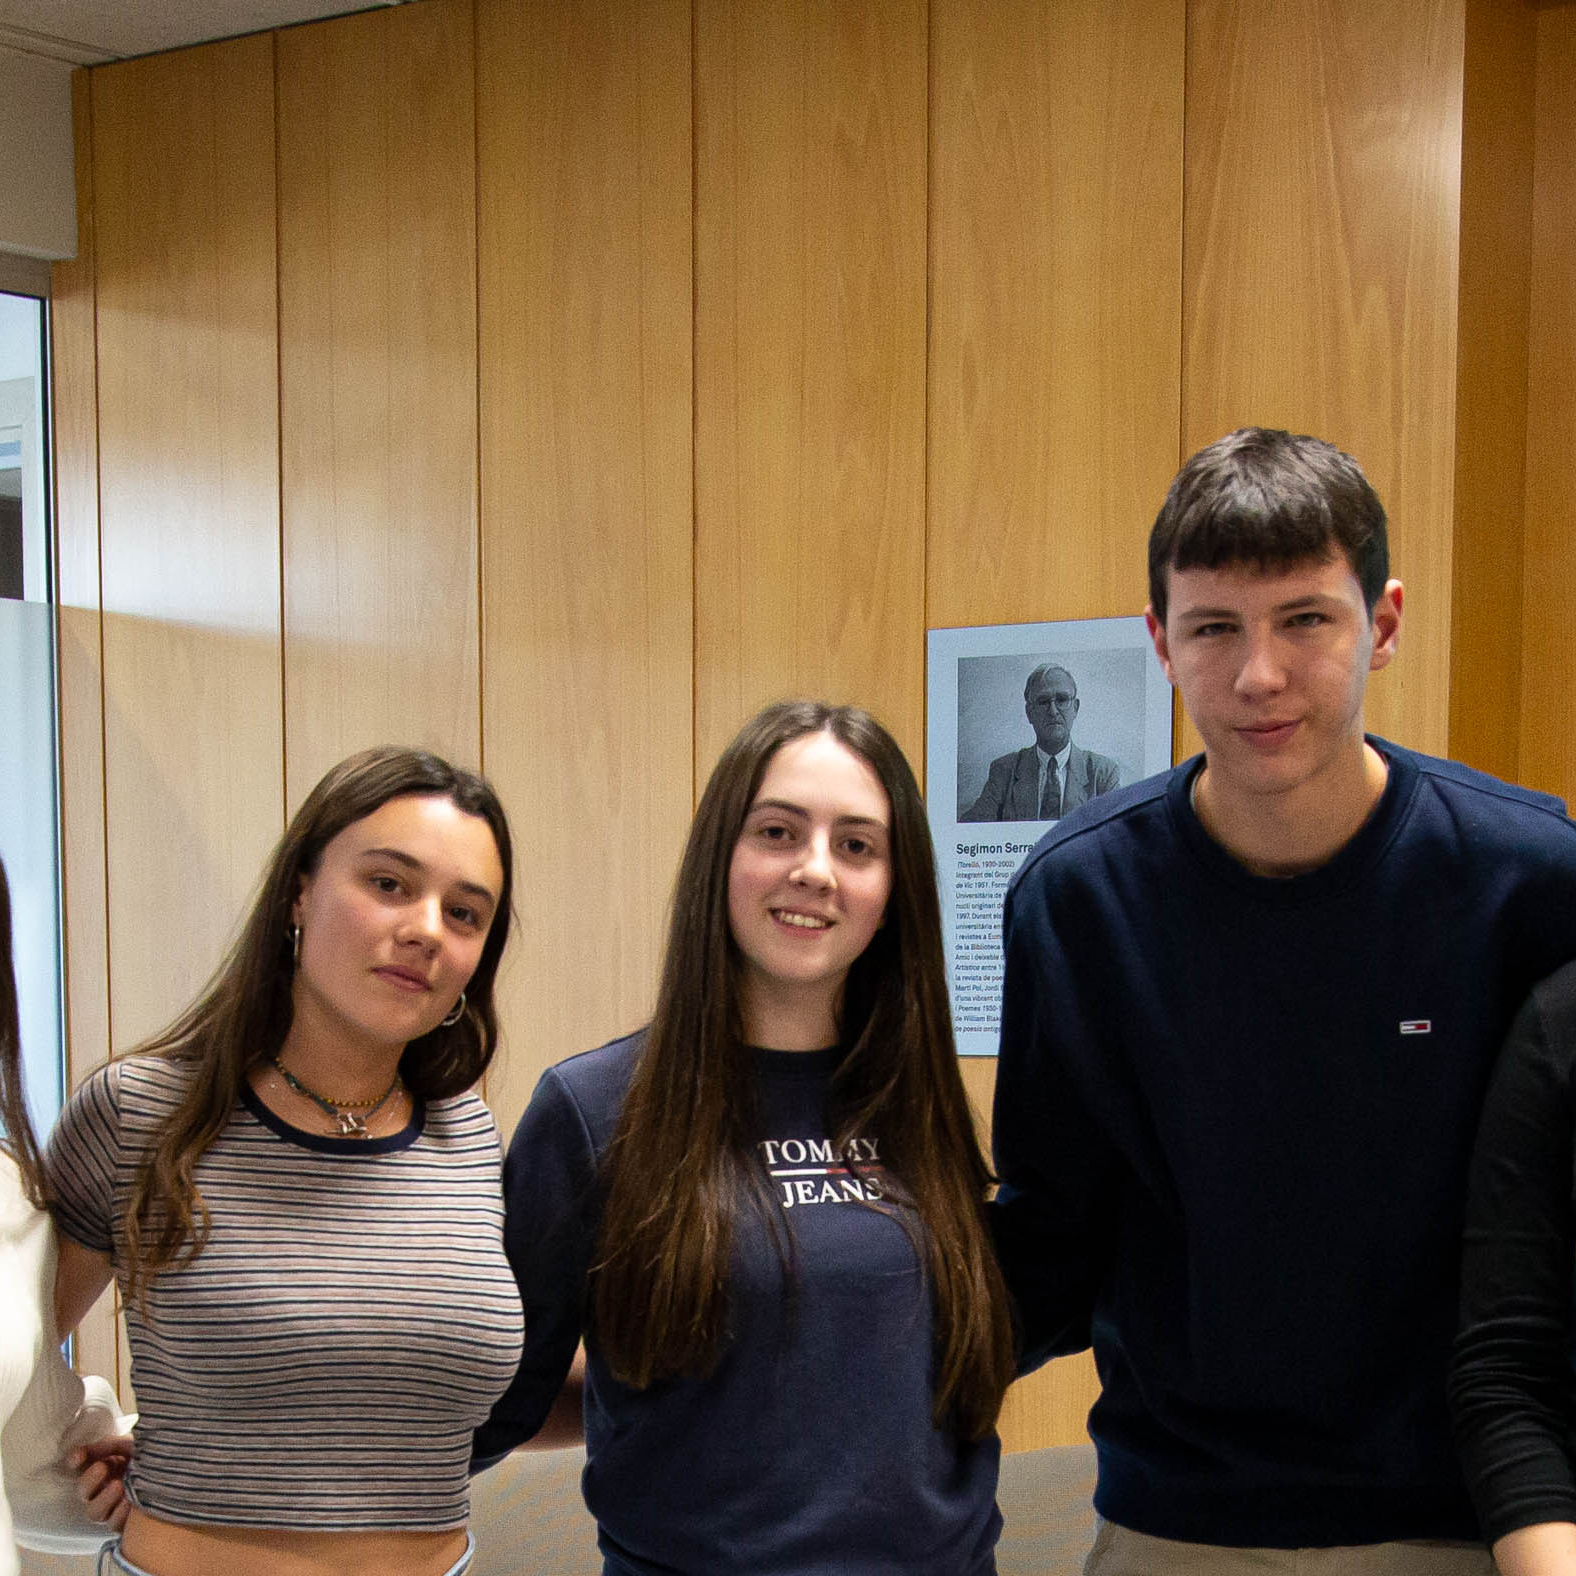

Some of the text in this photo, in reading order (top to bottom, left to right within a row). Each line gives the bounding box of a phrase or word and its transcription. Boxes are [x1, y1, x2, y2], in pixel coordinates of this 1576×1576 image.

[956, 842, 1034, 857] Segimon Serra
[781, 1178, 883, 1208] JEANS
